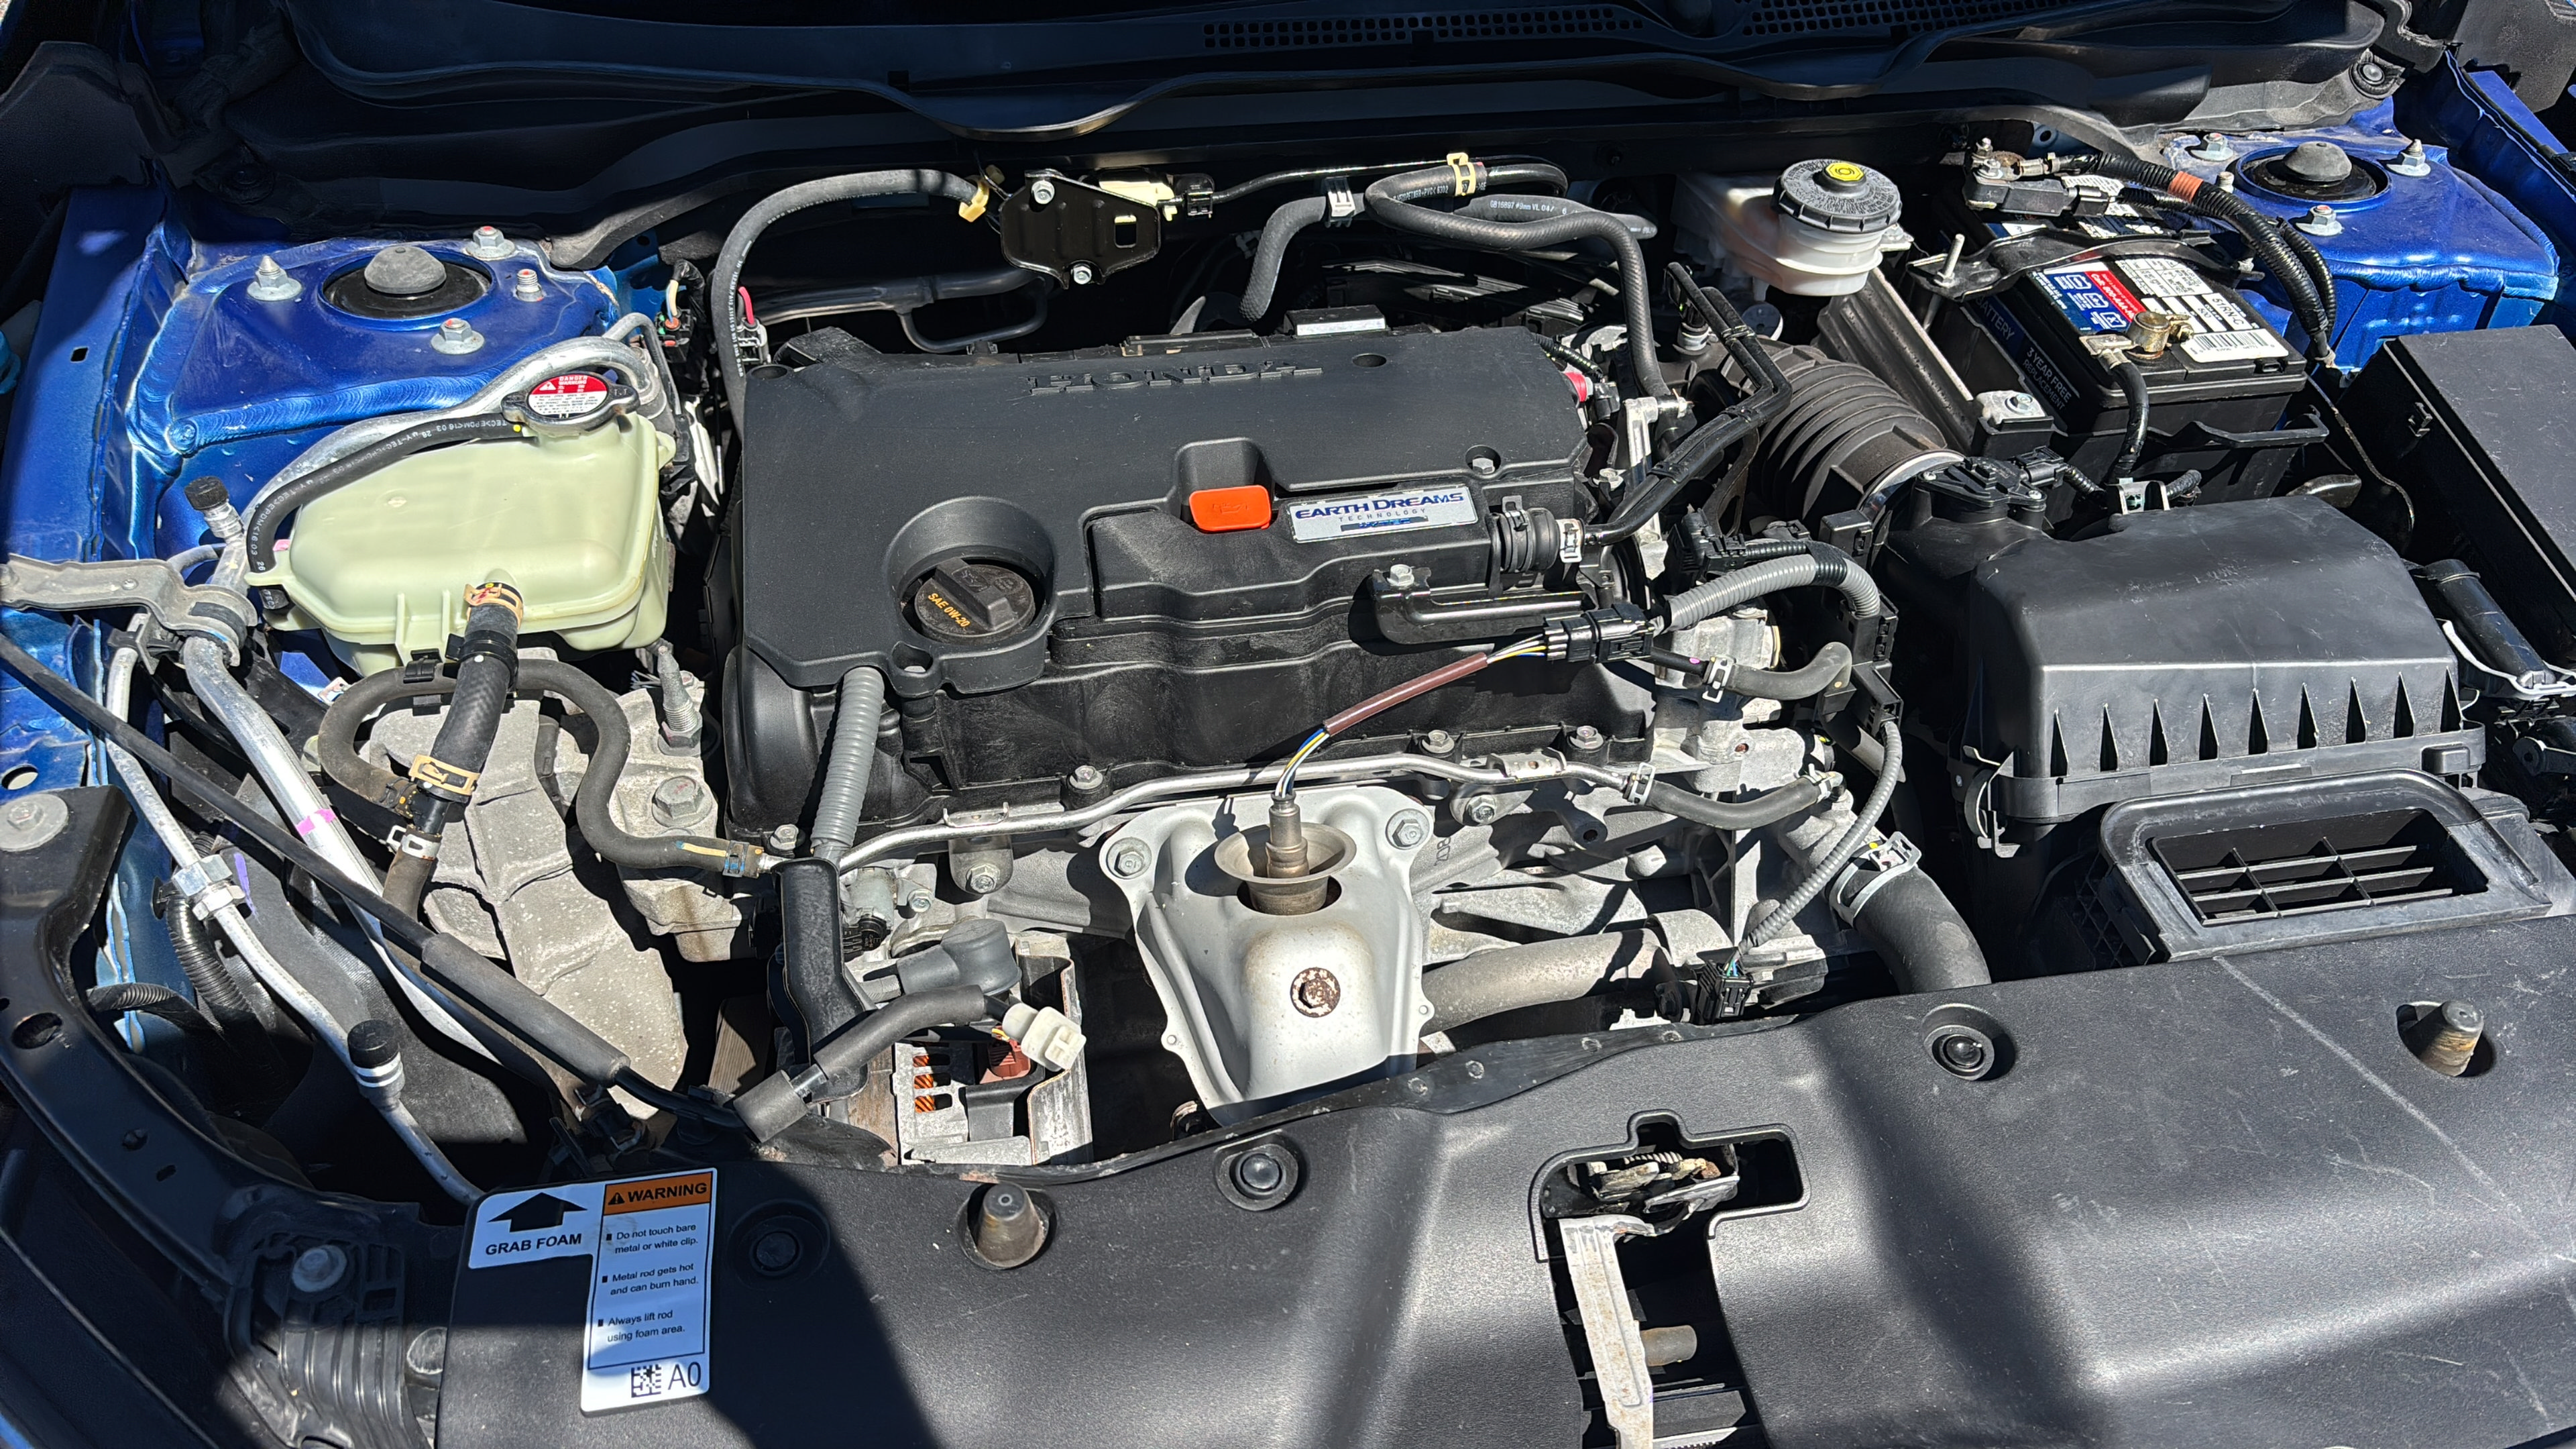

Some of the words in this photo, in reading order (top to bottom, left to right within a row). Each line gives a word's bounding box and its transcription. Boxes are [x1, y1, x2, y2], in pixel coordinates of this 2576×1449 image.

[1490, 200, 1514, 209] GB16897
[1532, 203, 1541, 211] VL
[2212, 298, 2245, 325] 51RN-C
[1026, 361, 1325, 396] HONDA
[2023, 359, 2066, 411] REPLACEMENT
[2026, 347, 2035, 358] 3
[2033, 354, 2054, 378] YEAR
[2050, 376, 2072, 404] FREE
[1296, 502, 1369, 519] EARTH
[1374, 492, 1464, 510] DREAMS
[1339, 508, 1426, 522] TECHNOLOGY
[928, 592, 948, 610] SAE
[944, 606, 971, 628] 0W-20
[627, 1181, 708, 1203] WARNING
[616, 1231, 630, 1241] Do
[632, 1229, 647, 1239] not
[648, 1226, 673, 1238] touch
[675, 1223, 697, 1235] bare
[485, 1239, 533, 1256] GRAB
[536, 1233, 583, 1249] FOAM
[614, 1242, 640, 1254] metal
[642, 1243, 653, 1252] or
[654, 1238, 679, 1250] white
[680, 1236, 699, 1248] clip.
[612, 1271, 638, 1283] Metal
[639, 1268, 656, 1279] rod
[657, 1267, 677, 1279] gets
[679, 1263, 695, 1273] hot
[610, 1284, 628, 1296] and
[630, 1283, 648, 1292] can
[649, 1279, 671, 1290] burn
[673, 1277, 699, 1287] hand.
[608, 1313, 642, 1327] Always
[643, 1311, 656, 1322] lift
[657, 1309, 673, 1321] rod
[607, 1330, 633, 1343] using
[634, 1326, 659, 1338] foam
[661, 1325, 686, 1336] area.
[667, 1361, 702, 1391] A0
